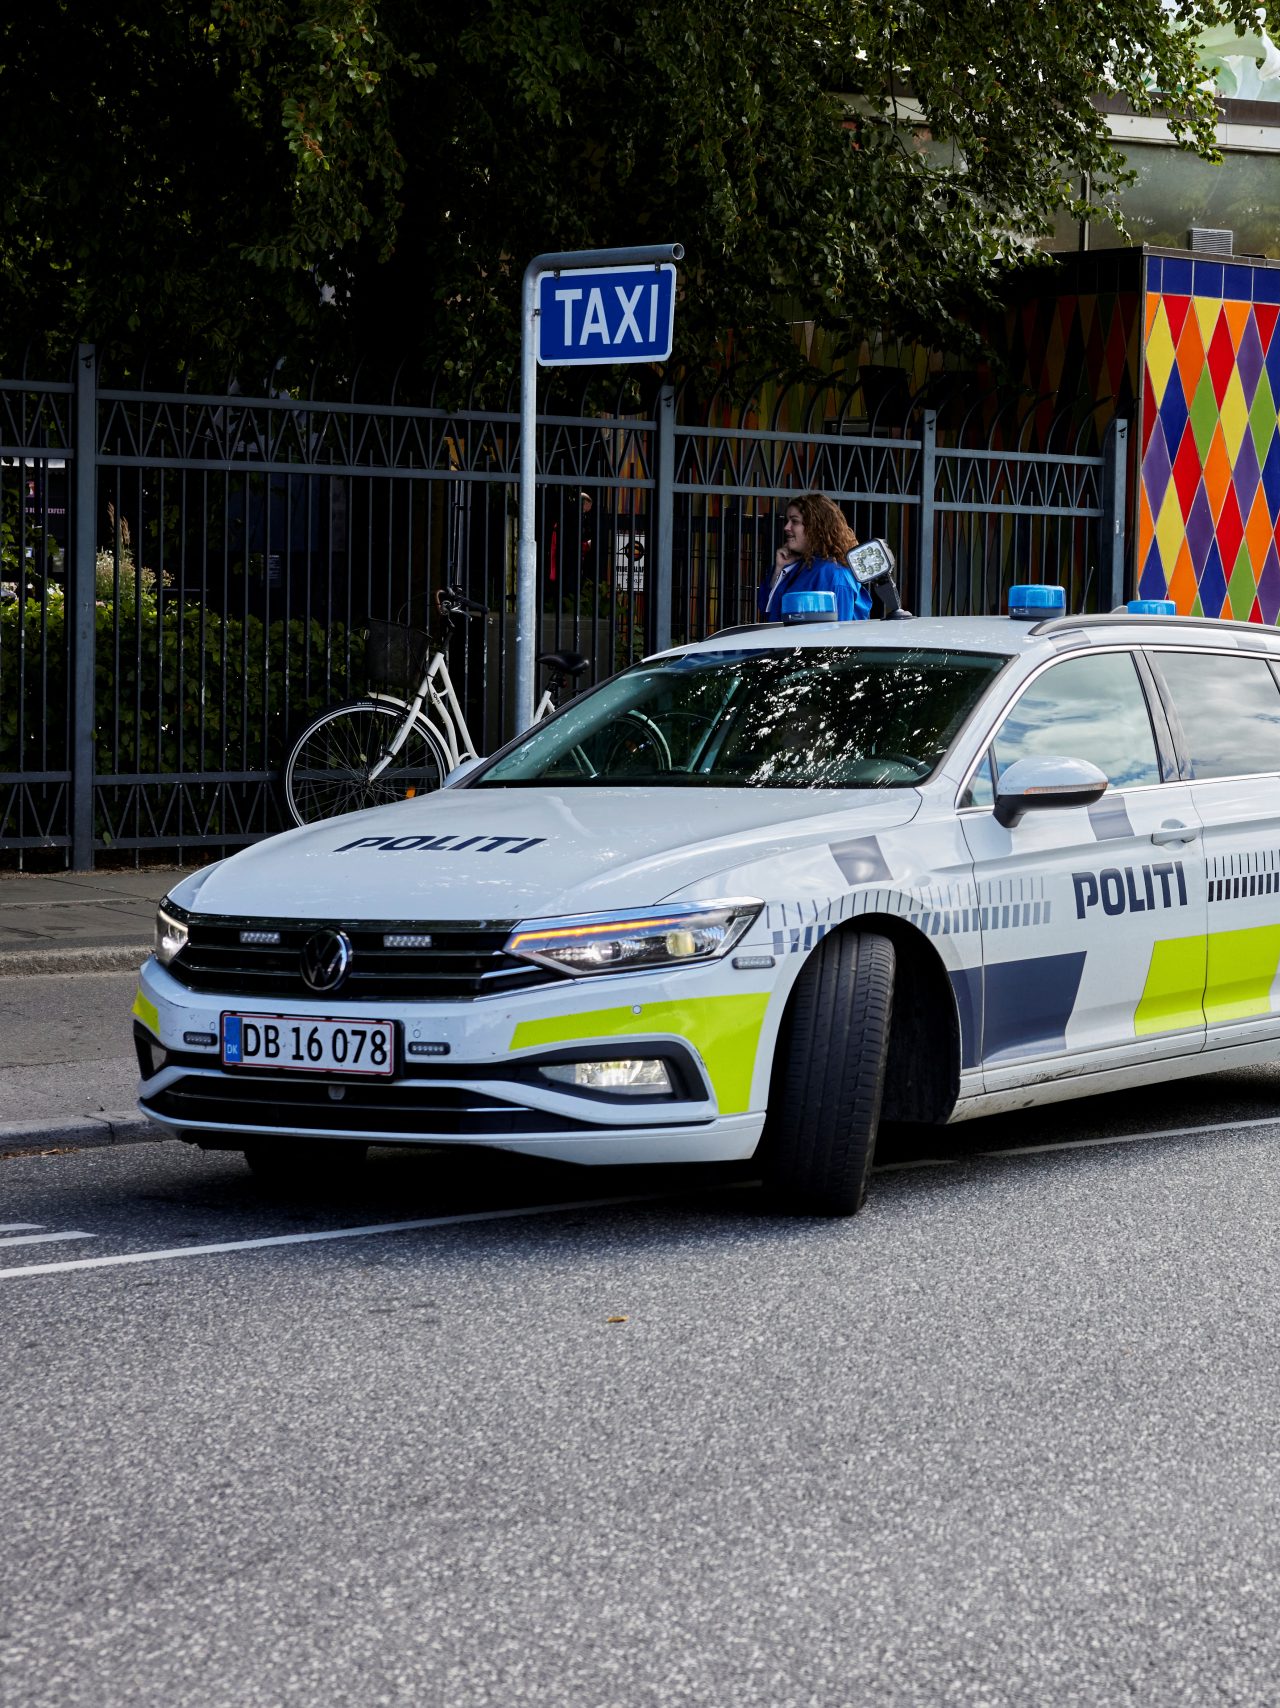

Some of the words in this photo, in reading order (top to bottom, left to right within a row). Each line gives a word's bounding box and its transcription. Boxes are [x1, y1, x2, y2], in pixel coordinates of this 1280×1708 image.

[555, 284, 659, 347] TAXI
[333, 836, 547, 853] POLITI
[1072, 861, 1188, 919] POLITI
[227, 1043, 238, 1055] DK
[243, 1023, 281, 1058] DB
[291, 1026, 323, 1062] 16
[332, 1028, 388, 1066] 078
